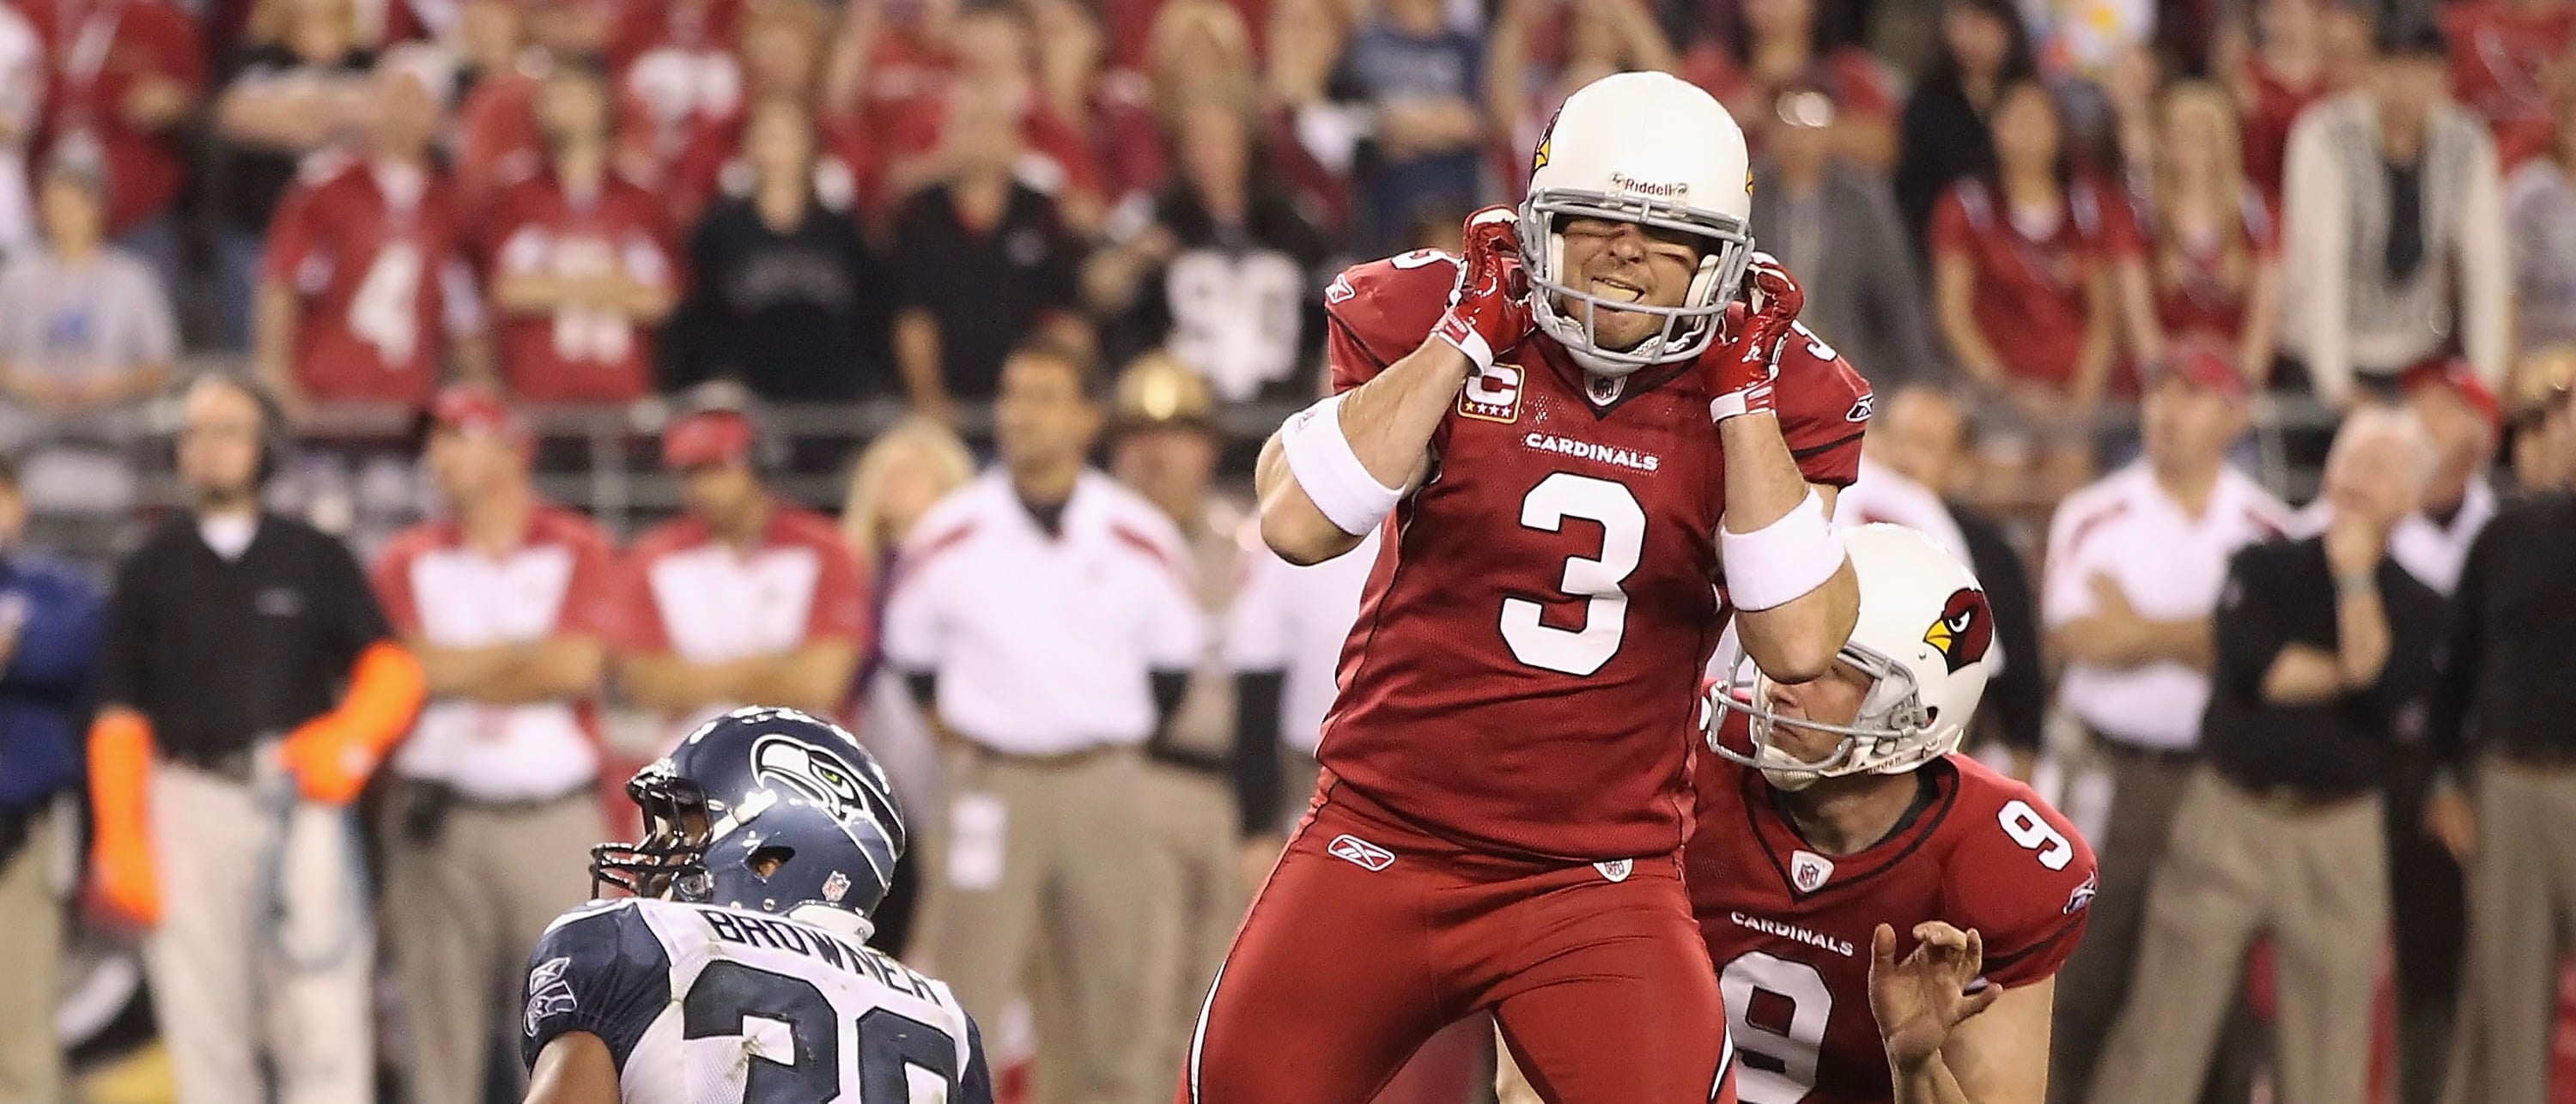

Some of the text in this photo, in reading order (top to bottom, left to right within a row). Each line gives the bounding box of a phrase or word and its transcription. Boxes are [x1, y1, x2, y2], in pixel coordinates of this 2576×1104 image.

[1624, 178, 1672, 197] Riddell
[1466, 364, 1519, 406] C
[1525, 431, 1660, 472] CARDINALS
[1499, 470, 1647, 676] 3
[1997, 799, 2074, 871] 9
[696, 908, 943, 1008] BROWNER
[1730, 910, 1855, 957] CARDINALS
[1720, 949, 1834, 1104] 9
